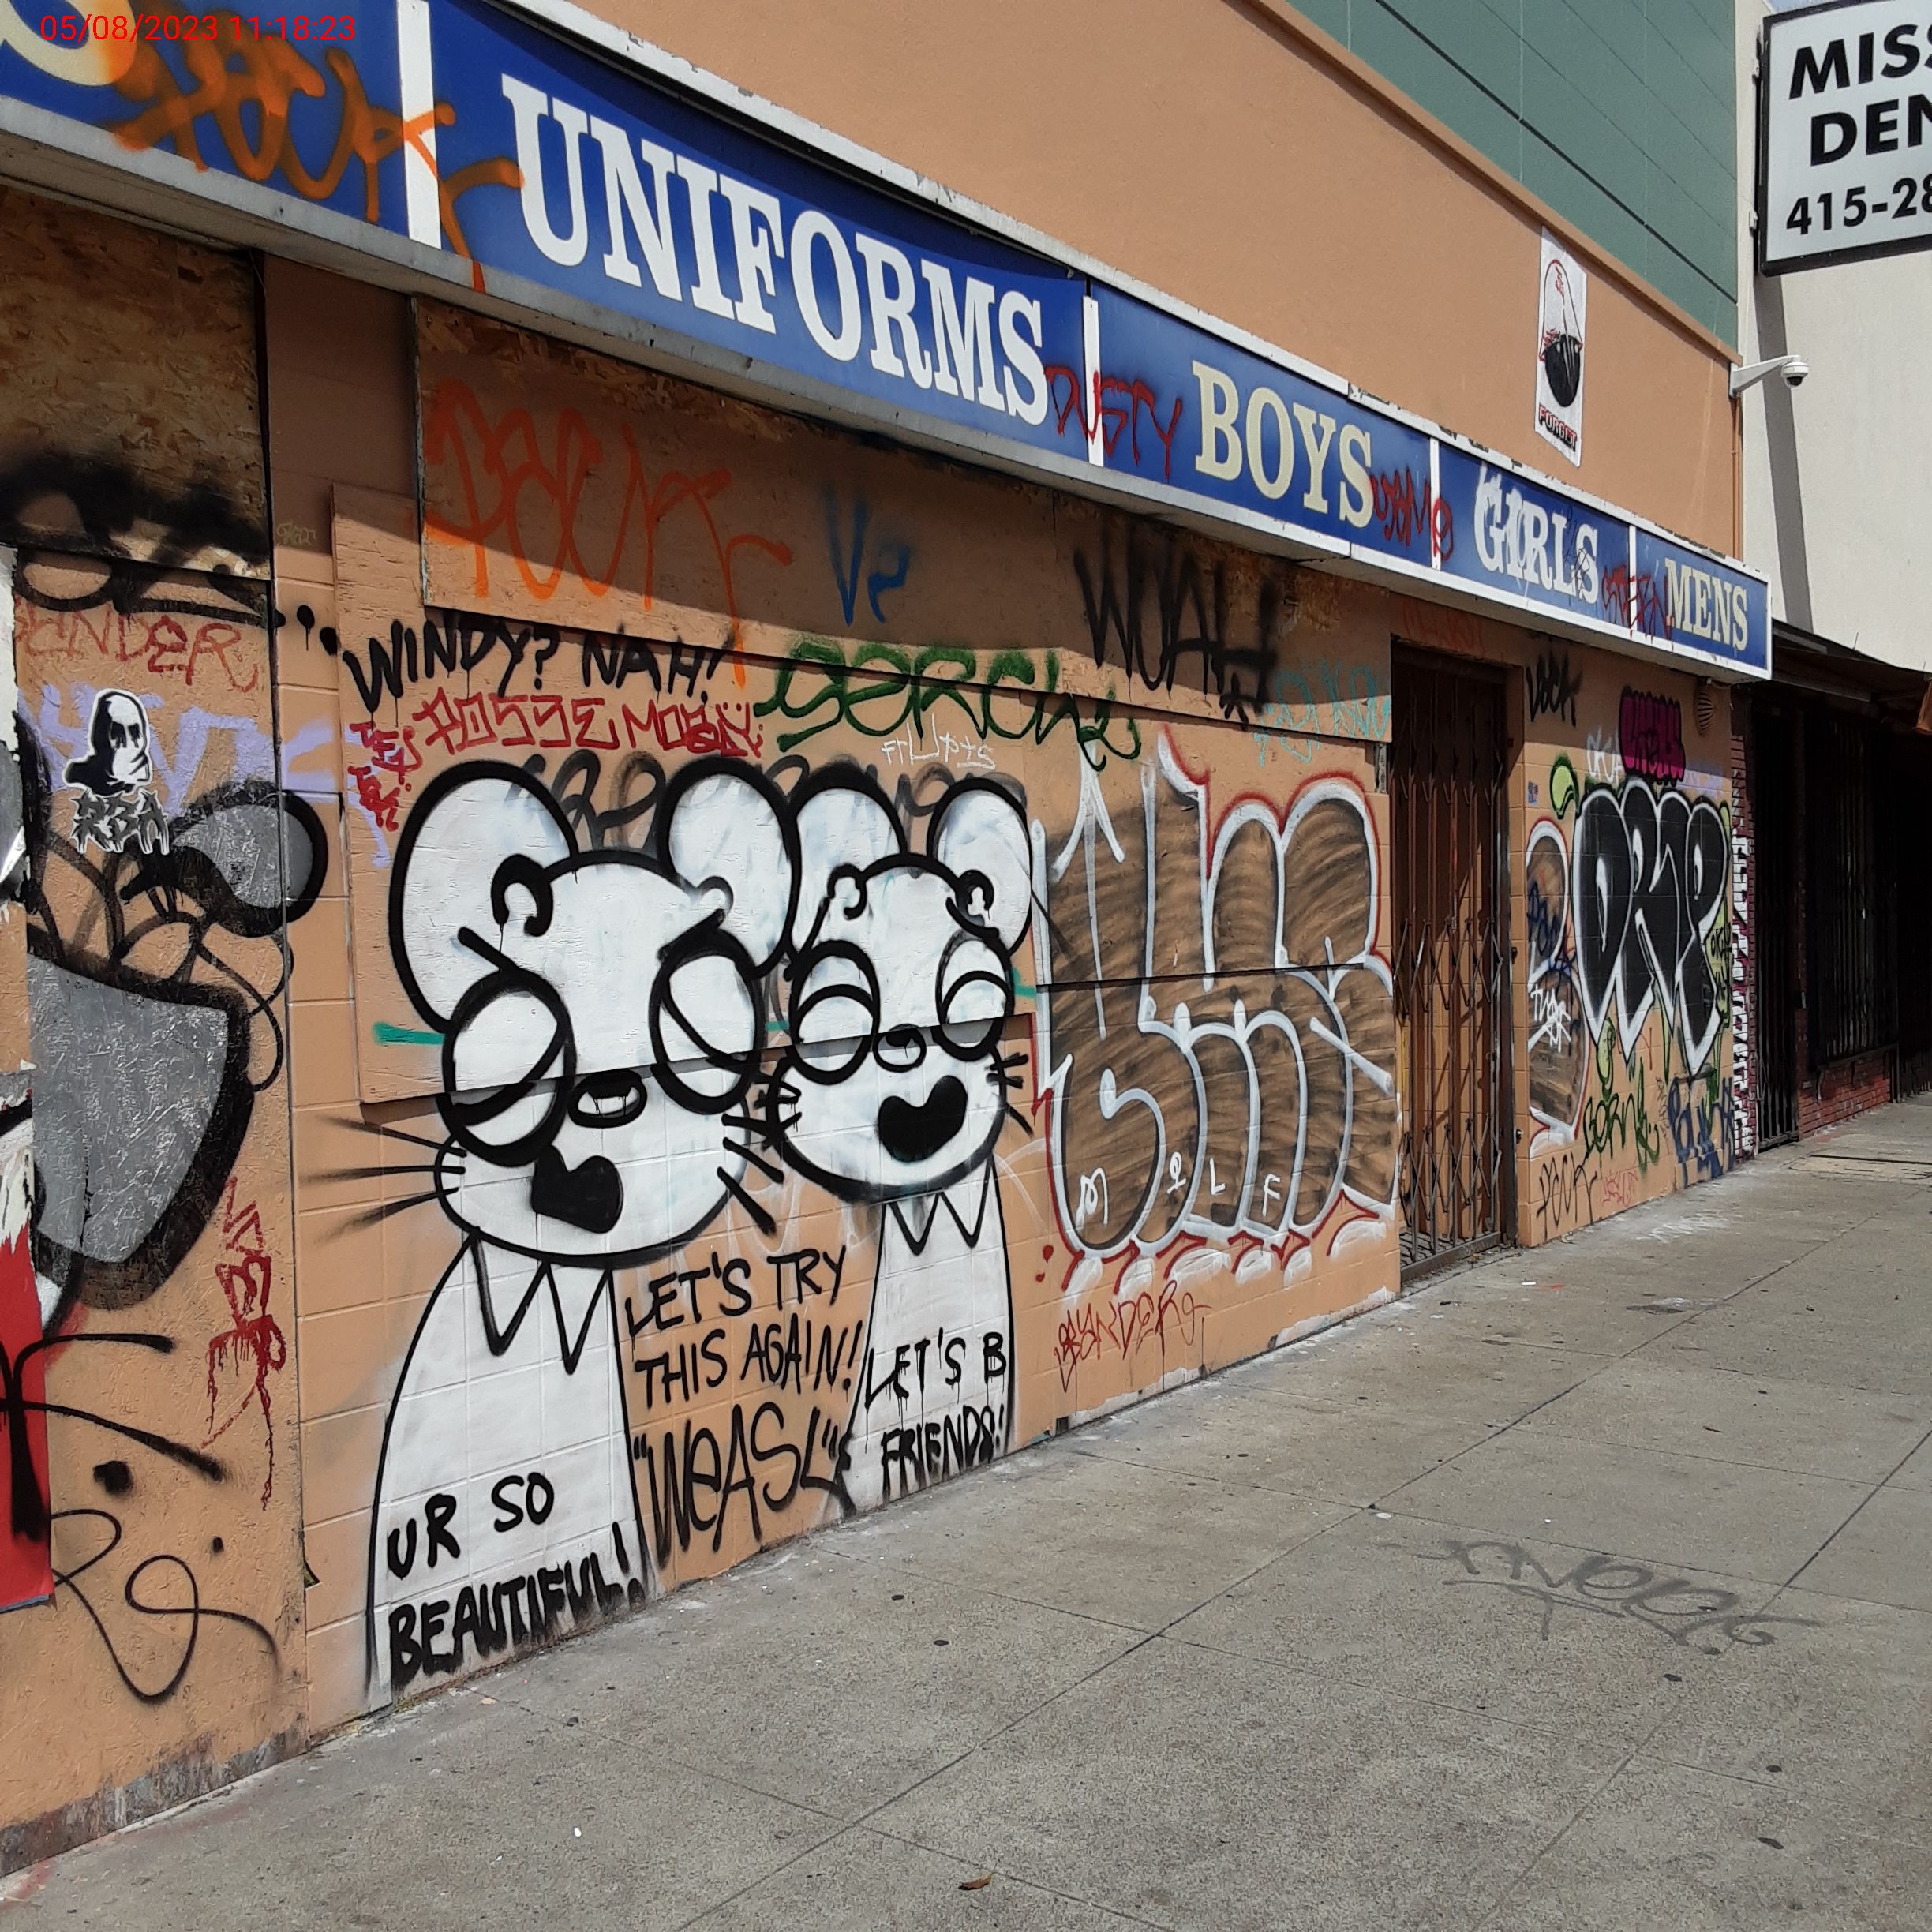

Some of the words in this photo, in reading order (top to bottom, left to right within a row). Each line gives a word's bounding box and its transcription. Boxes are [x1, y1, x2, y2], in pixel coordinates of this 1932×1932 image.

[1788, 24, 1932, 100] MIS
[501, 73, 1050, 427] UNIFORMS
[1192, 359, 1374, 528] BOYS
[1473, 464, 1599, 605] GIRLS
[1664, 557, 1748, 651] MENS
[343, 619, 559, 710] WINDY?
[581, 623, 736, 702] NAH!
[624, 1252, 753, 1339] LET'S
[766, 1245, 847, 1311] TRY
[635, 1327, 728, 1410] THIS
[740, 1312, 863, 1398] AGAIN!
[865, 1326, 967, 1410] LET'S
[983, 1331, 1008, 1386] B
[387, 1492, 461, 1580] UR
[490, 1471, 555, 1533] SO
[388, 1521, 646, 1694] BEAUTIFUL!
